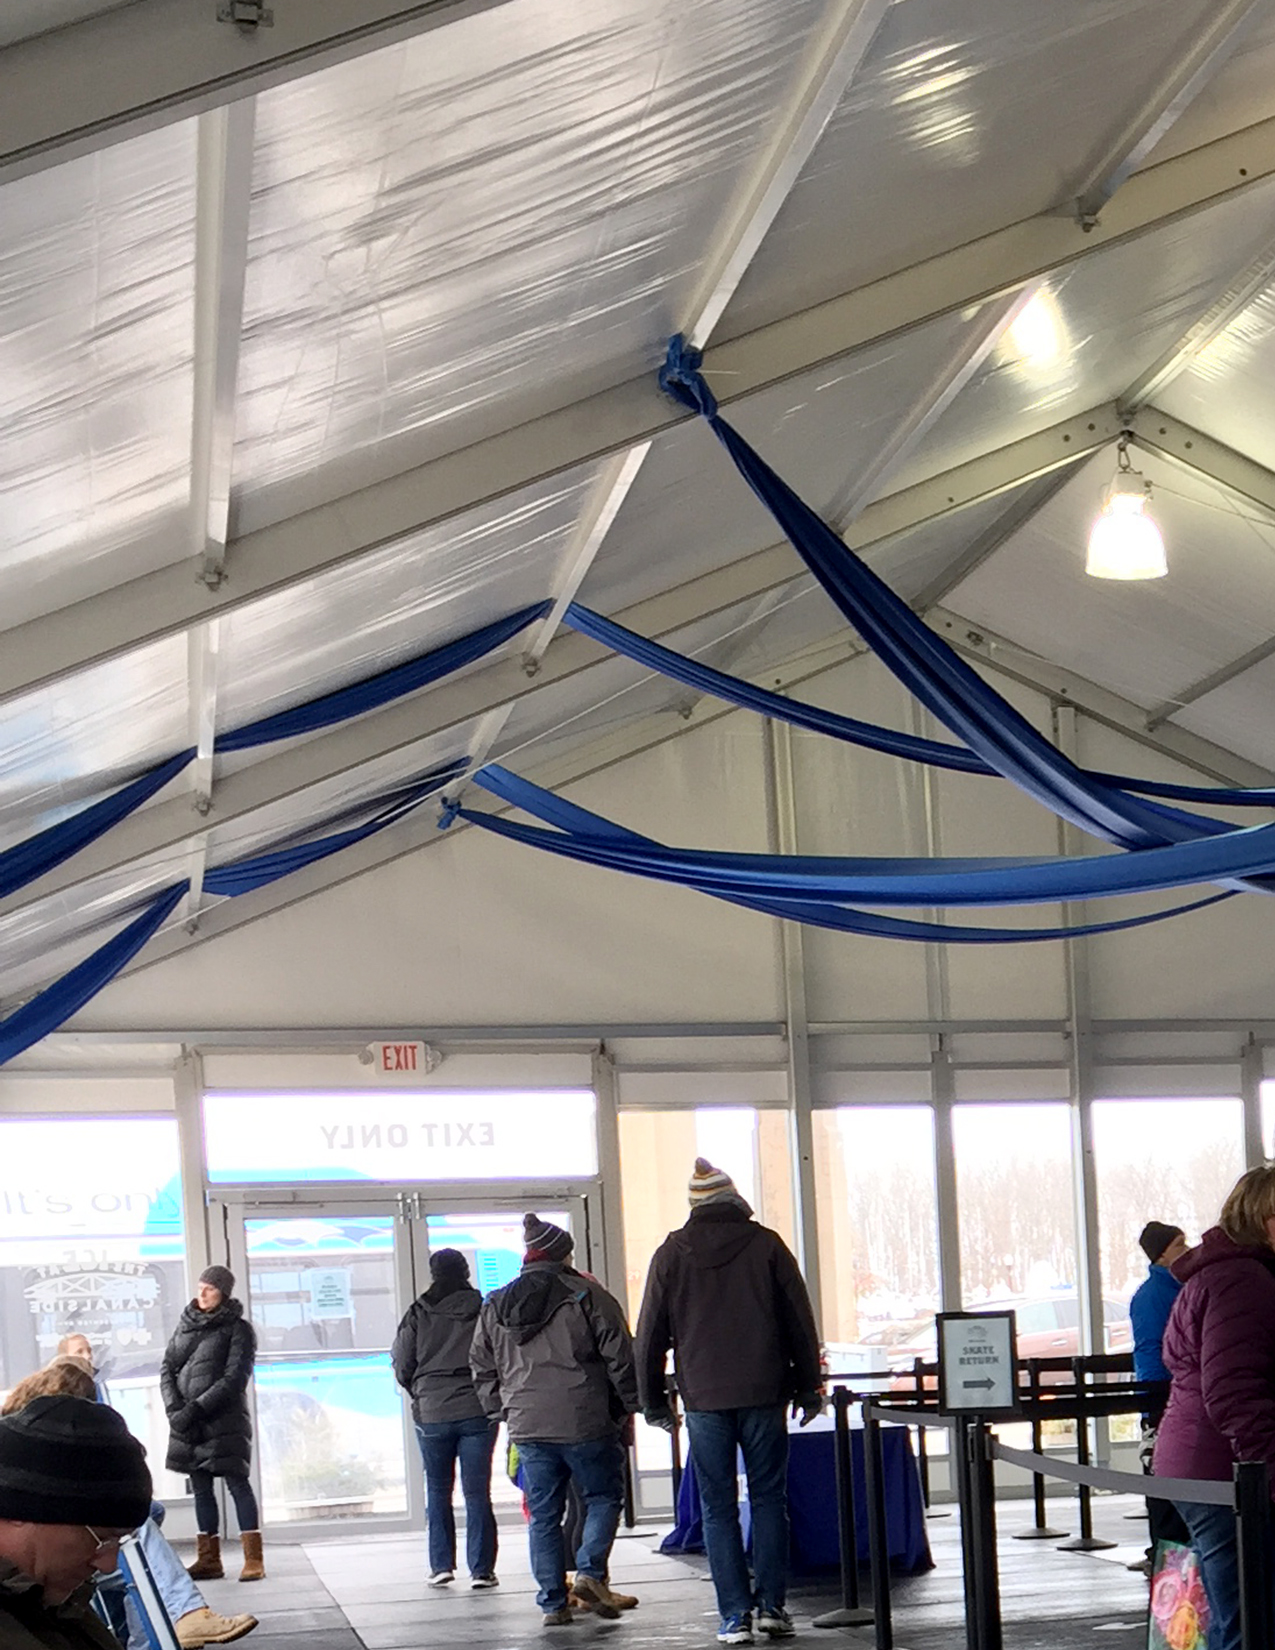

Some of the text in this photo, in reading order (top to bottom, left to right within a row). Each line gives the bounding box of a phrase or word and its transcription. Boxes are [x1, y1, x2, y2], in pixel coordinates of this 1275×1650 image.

[382, 1045, 418, 1071] EXIT
[962, 1345, 995, 1355] SKATE
[959, 1356, 999, 1365] RETURN
